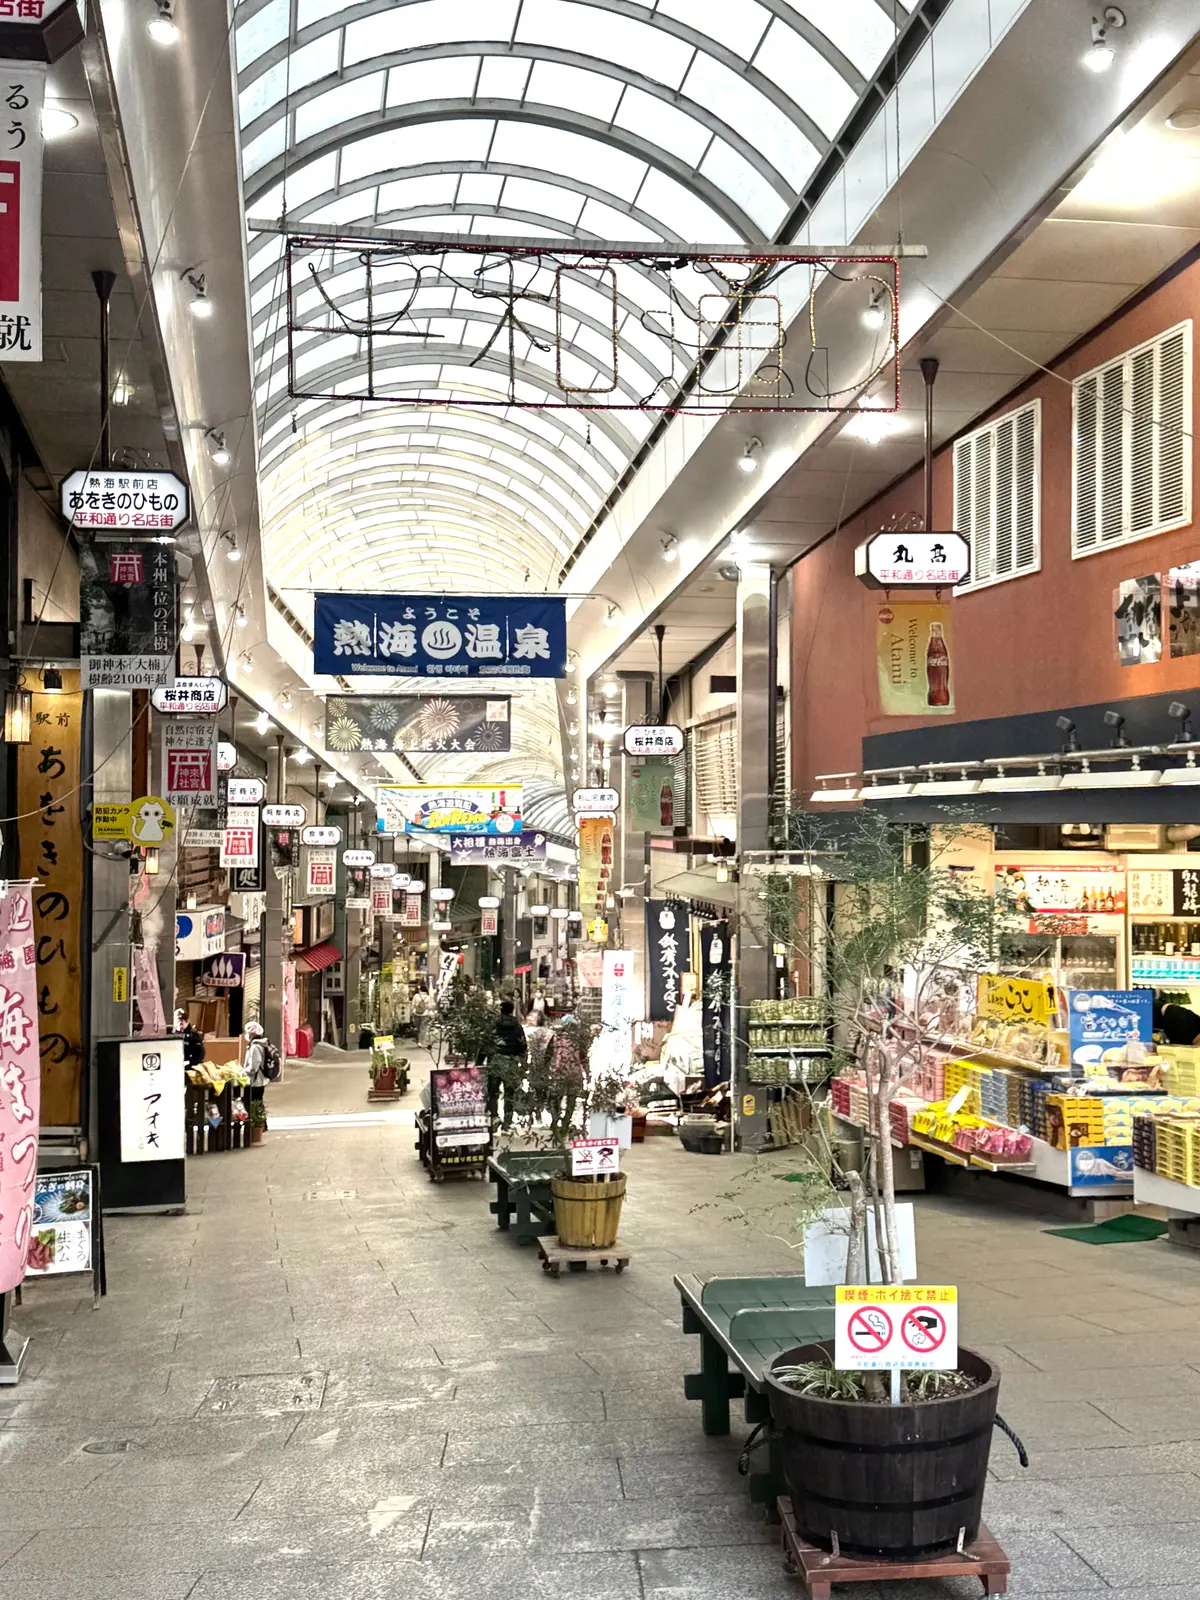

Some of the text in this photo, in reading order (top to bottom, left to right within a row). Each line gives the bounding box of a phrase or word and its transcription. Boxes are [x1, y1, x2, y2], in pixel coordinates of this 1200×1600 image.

[89, 478, 158, 489] 熱海駅前店
[68, 491, 179, 511] あをきのひもの
[74, 512, 174, 527] 平和通り名店街
[880, 569, 959, 581] 平和通り名店街
[152, 552, 168, 651] 本州一位の巨樹
[402, 607, 482, 622] ようこそ
[908, 619, 918, 678] Welcome to
[891, 633, 907, 685] Atami
[164, 690, 216, 701] 桜井商店
[159, 701, 220, 712] 平和通り名店街
[33, 711, 71, 727] 駅前
[165, 725, 214, 736] 自然に宿る
[635, 736, 674, 747] 桜井商店
[95, 807, 130, 815] 防犯カメラ
[95, 815, 117, 823] 作動中
[452, 837, 486, 848] 大相撲
[36, 746, 69, 1063] あをきのひもの
[143, 1093, 162, 1148] アオキ
[57, 1230, 71, 1263] 生ハム
[77, 1229, 87, 1261] まぐろ
